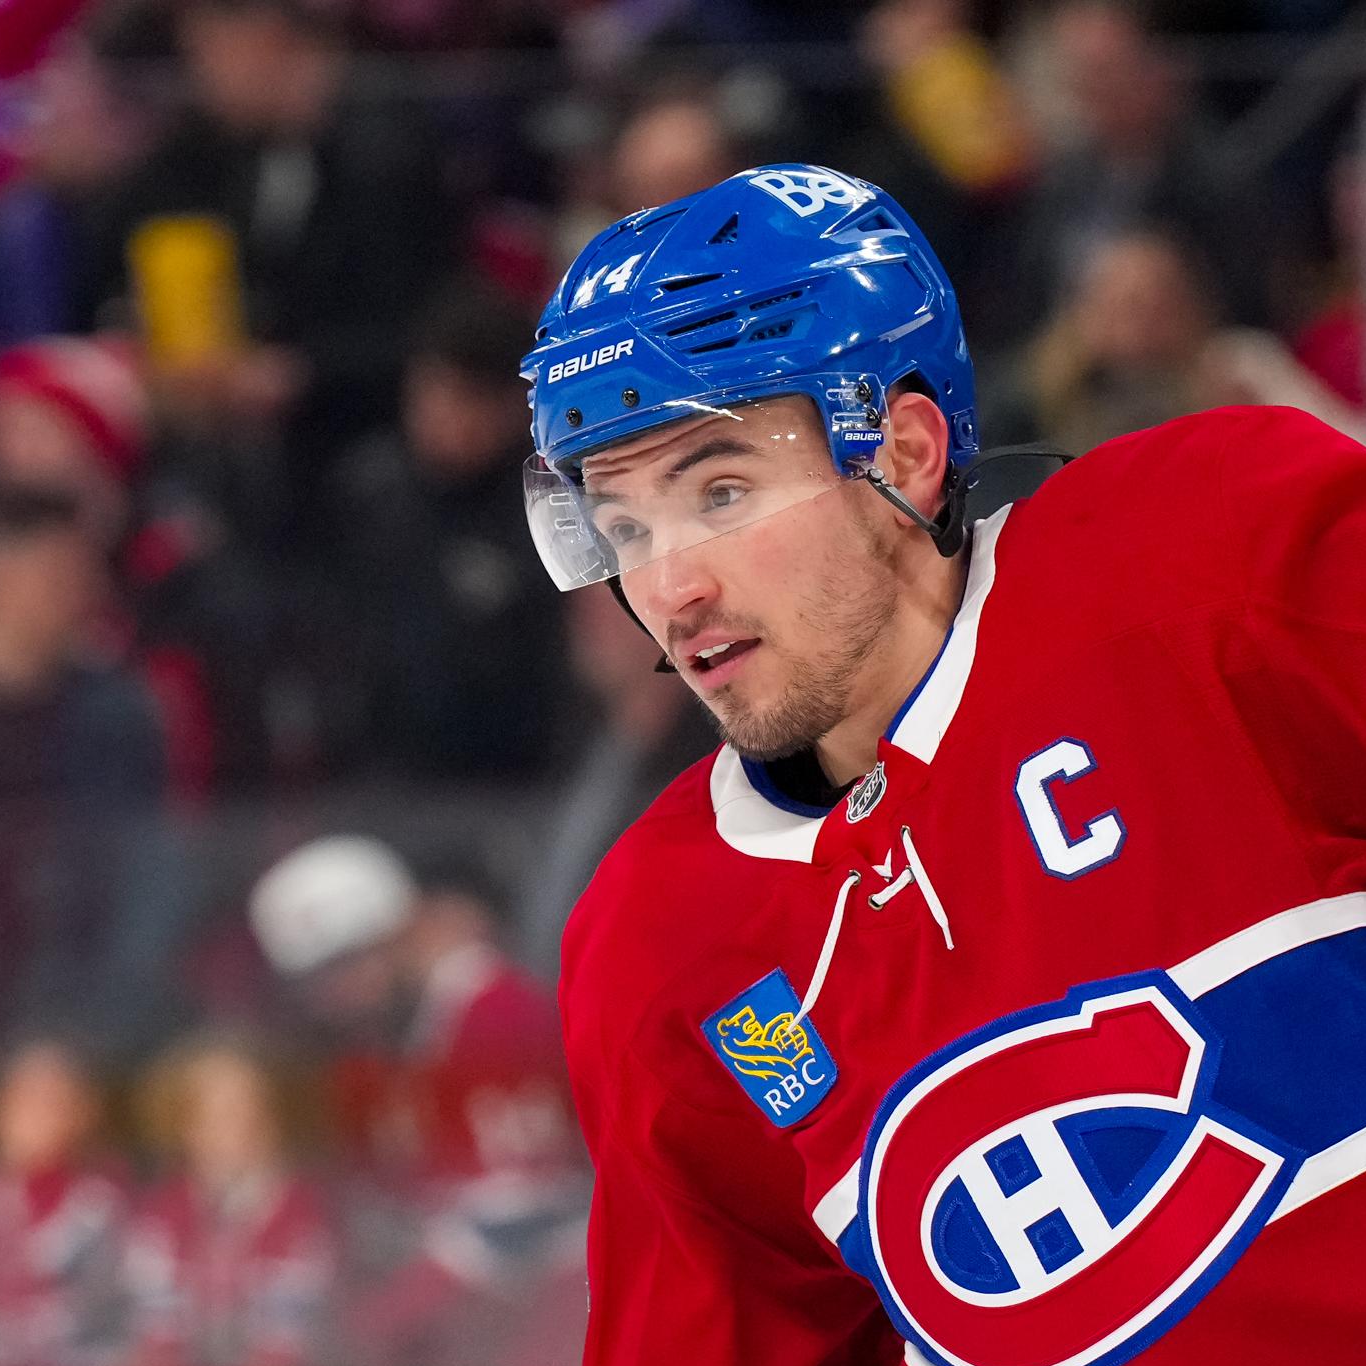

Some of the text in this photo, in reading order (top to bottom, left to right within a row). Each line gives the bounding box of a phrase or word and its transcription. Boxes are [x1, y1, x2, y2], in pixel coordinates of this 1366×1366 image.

[547, 338, 634, 385] BAUER
[844, 432, 882, 441] BAUER
[1013, 735, 1128, 881] C
[763, 1057, 826, 1116] RBC
